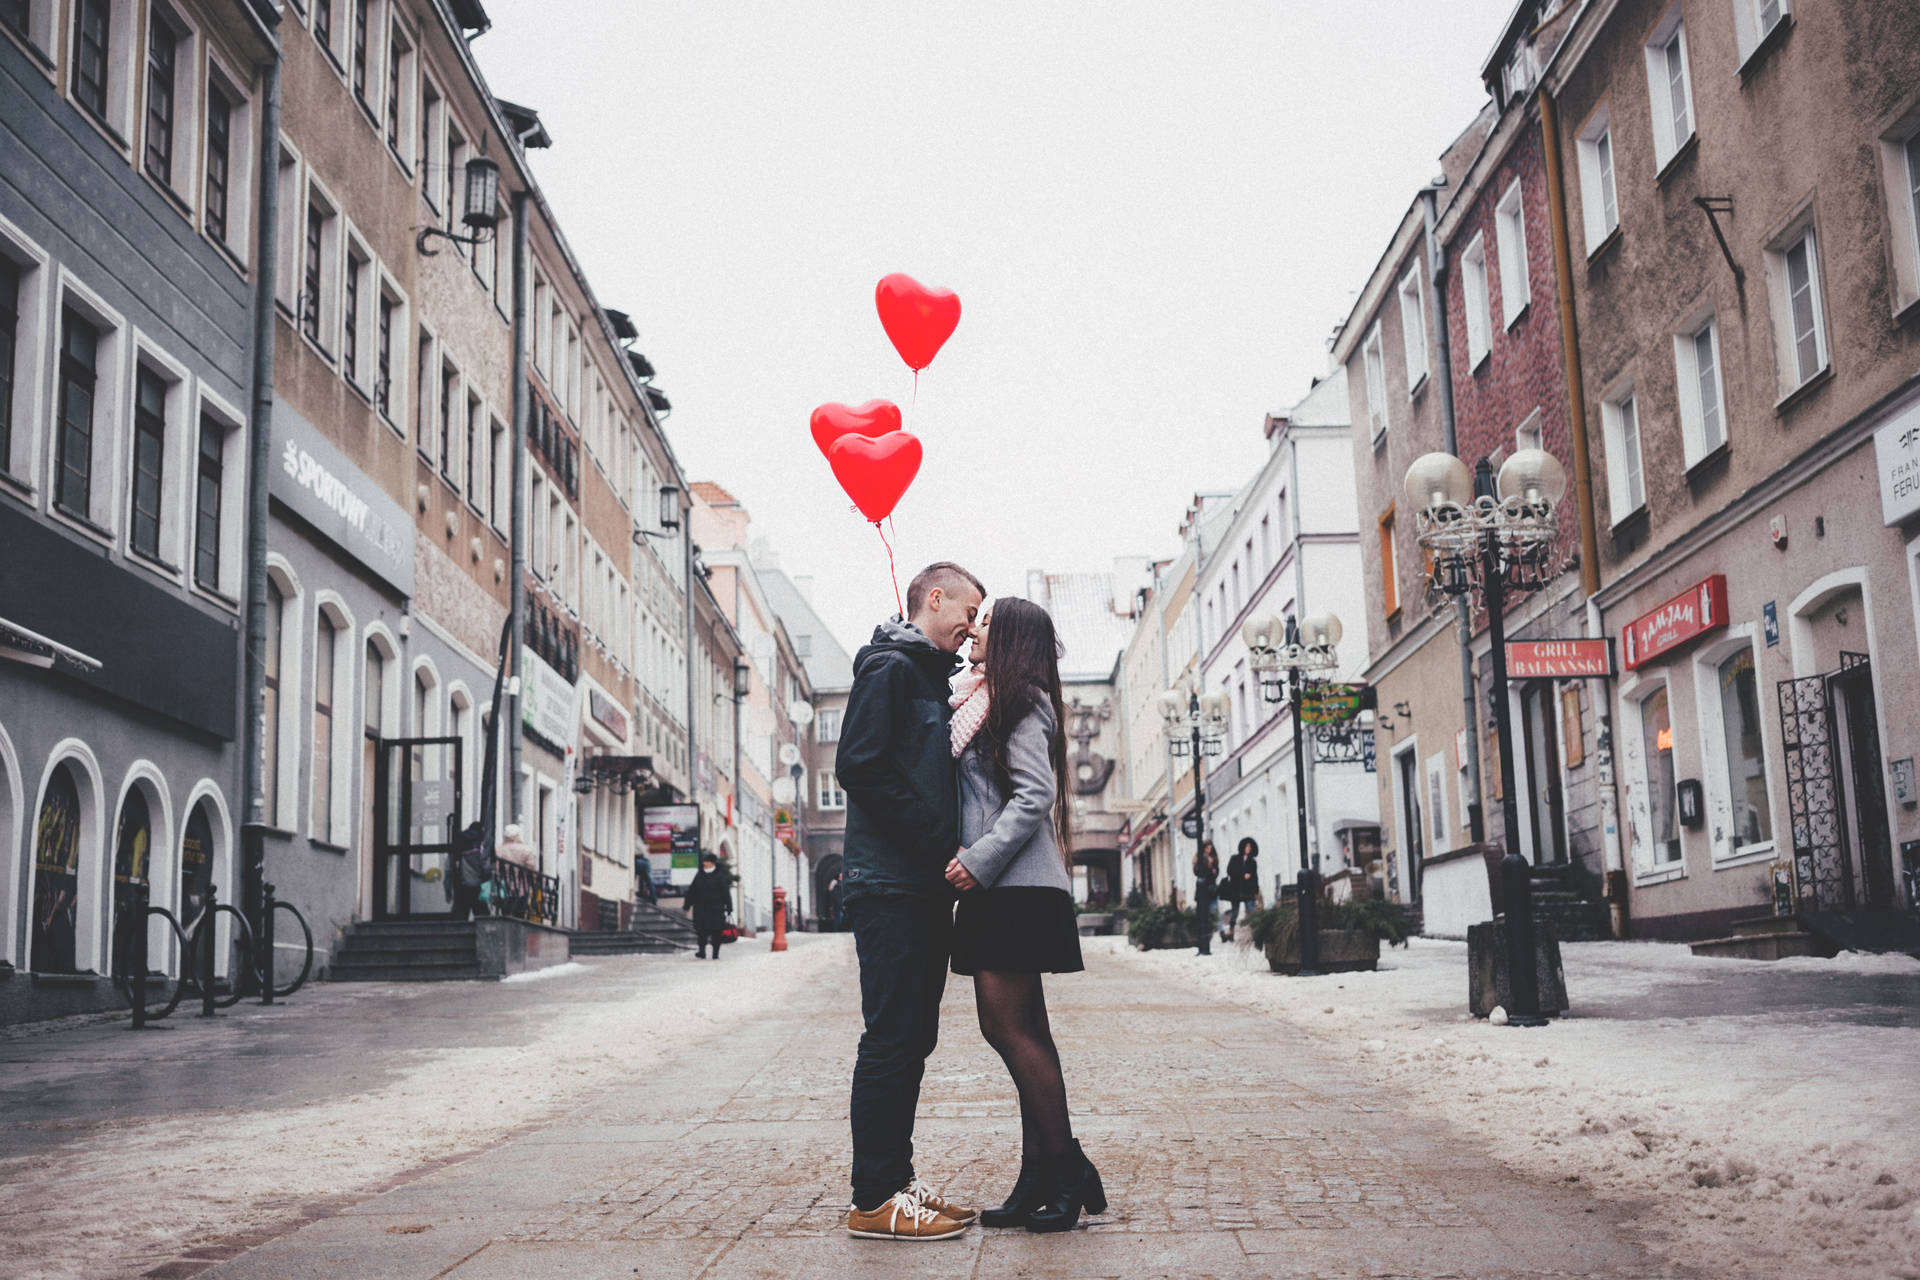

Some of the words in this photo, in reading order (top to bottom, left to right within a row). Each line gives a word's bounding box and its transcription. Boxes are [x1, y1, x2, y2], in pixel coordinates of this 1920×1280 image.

[1891, 456, 1920, 481] FRAN
[297, 449, 369, 532] SPORTOWY
[1642, 603, 1694, 653] JAM-JAM
[1656, 628, 1679, 648] GRILL
[1533, 642, 1581, 657] GRILL
[1515, 656, 1603, 675] BALKAŃSKI
